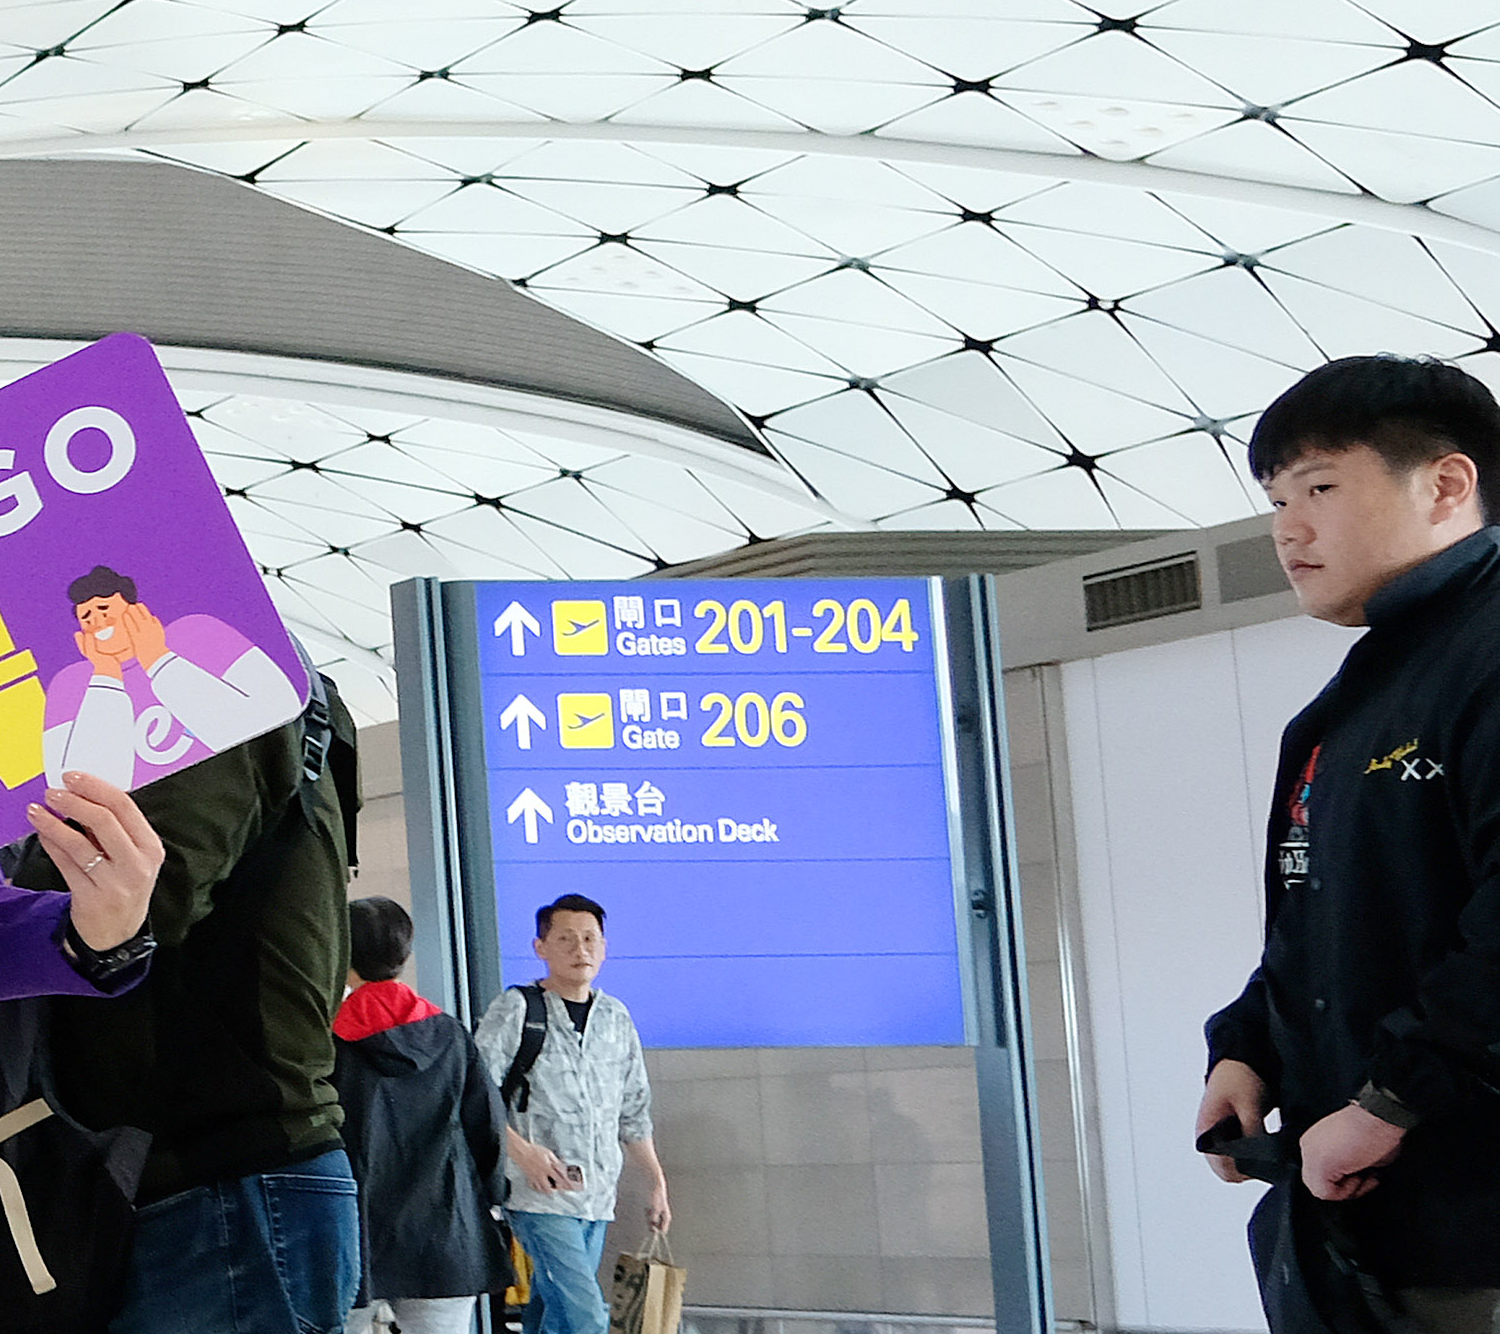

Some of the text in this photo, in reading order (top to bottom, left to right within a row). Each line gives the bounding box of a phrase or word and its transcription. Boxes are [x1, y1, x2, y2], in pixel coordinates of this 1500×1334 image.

[612, 595, 682, 630] 閘口
[694, 598, 919, 655] 201-204
[616, 631, 687, 656] Gates
[619, 688, 689, 723] 閘口
[700, 691, 807, 748] 206
[622, 724, 681, 750] Gate
[564, 780, 666, 817] 觀景台
[566, 817, 780, 844] Observation Deck
